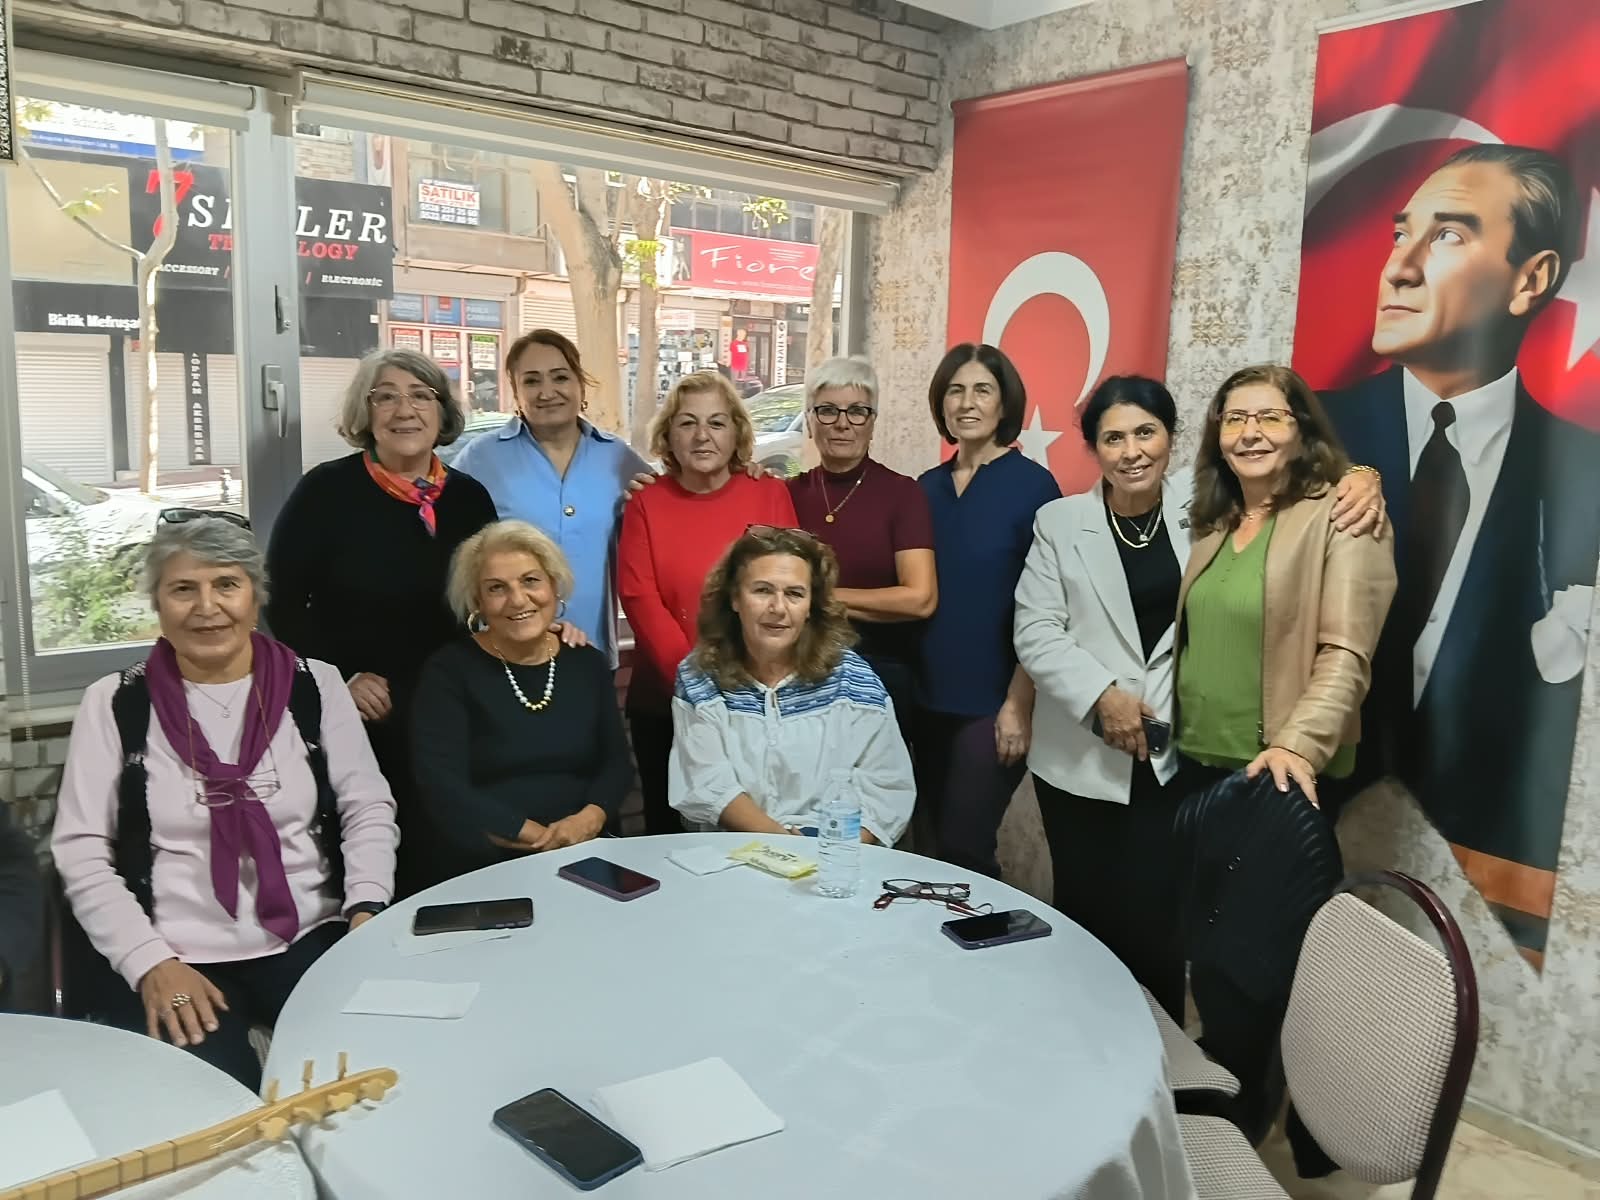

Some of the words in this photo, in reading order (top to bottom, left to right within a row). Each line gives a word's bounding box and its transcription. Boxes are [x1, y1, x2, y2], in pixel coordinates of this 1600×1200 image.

[421, 185, 476, 203] SATILIK
[700, 245, 815, 281] Fiore
[48, 312, 85, 327] Birlik
